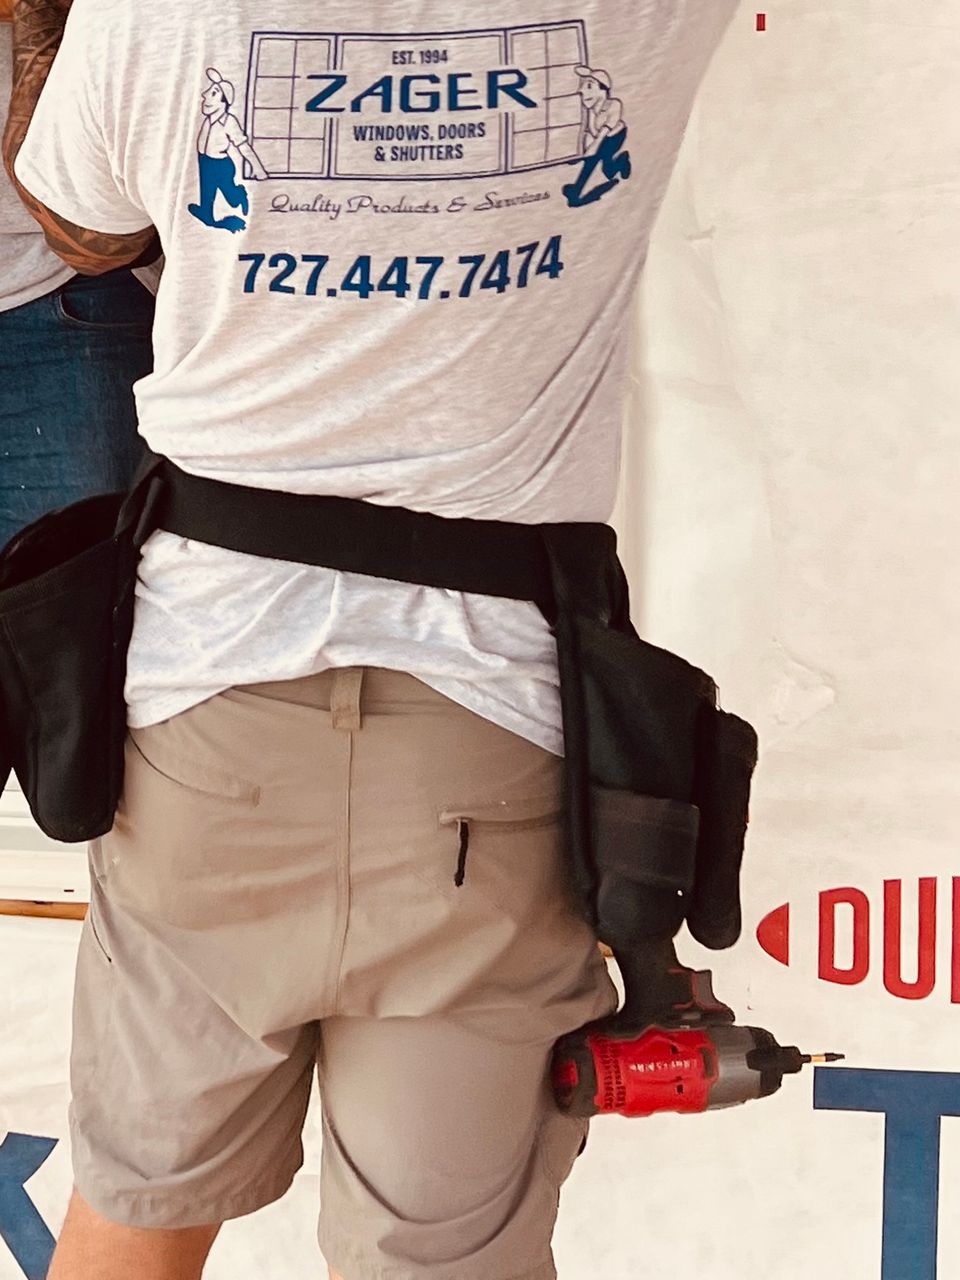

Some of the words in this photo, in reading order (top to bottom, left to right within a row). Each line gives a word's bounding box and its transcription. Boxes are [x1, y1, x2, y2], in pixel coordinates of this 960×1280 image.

[391, 51, 416, 64] EST.
[420, 50, 448, 64] 1994
[305, 69, 538, 113] ZAGER
[438, 122, 486, 140] DOORS
[374, 145, 386, 161] &
[390, 144, 464, 161] SHUTTERS
[268, 193, 342, 220] Quality
[345, 195, 440, 214] Products
[446, 196, 467, 212] &
[473, 190, 551, 211] Services
[238, 235, 564, 300] 727.447.7474
